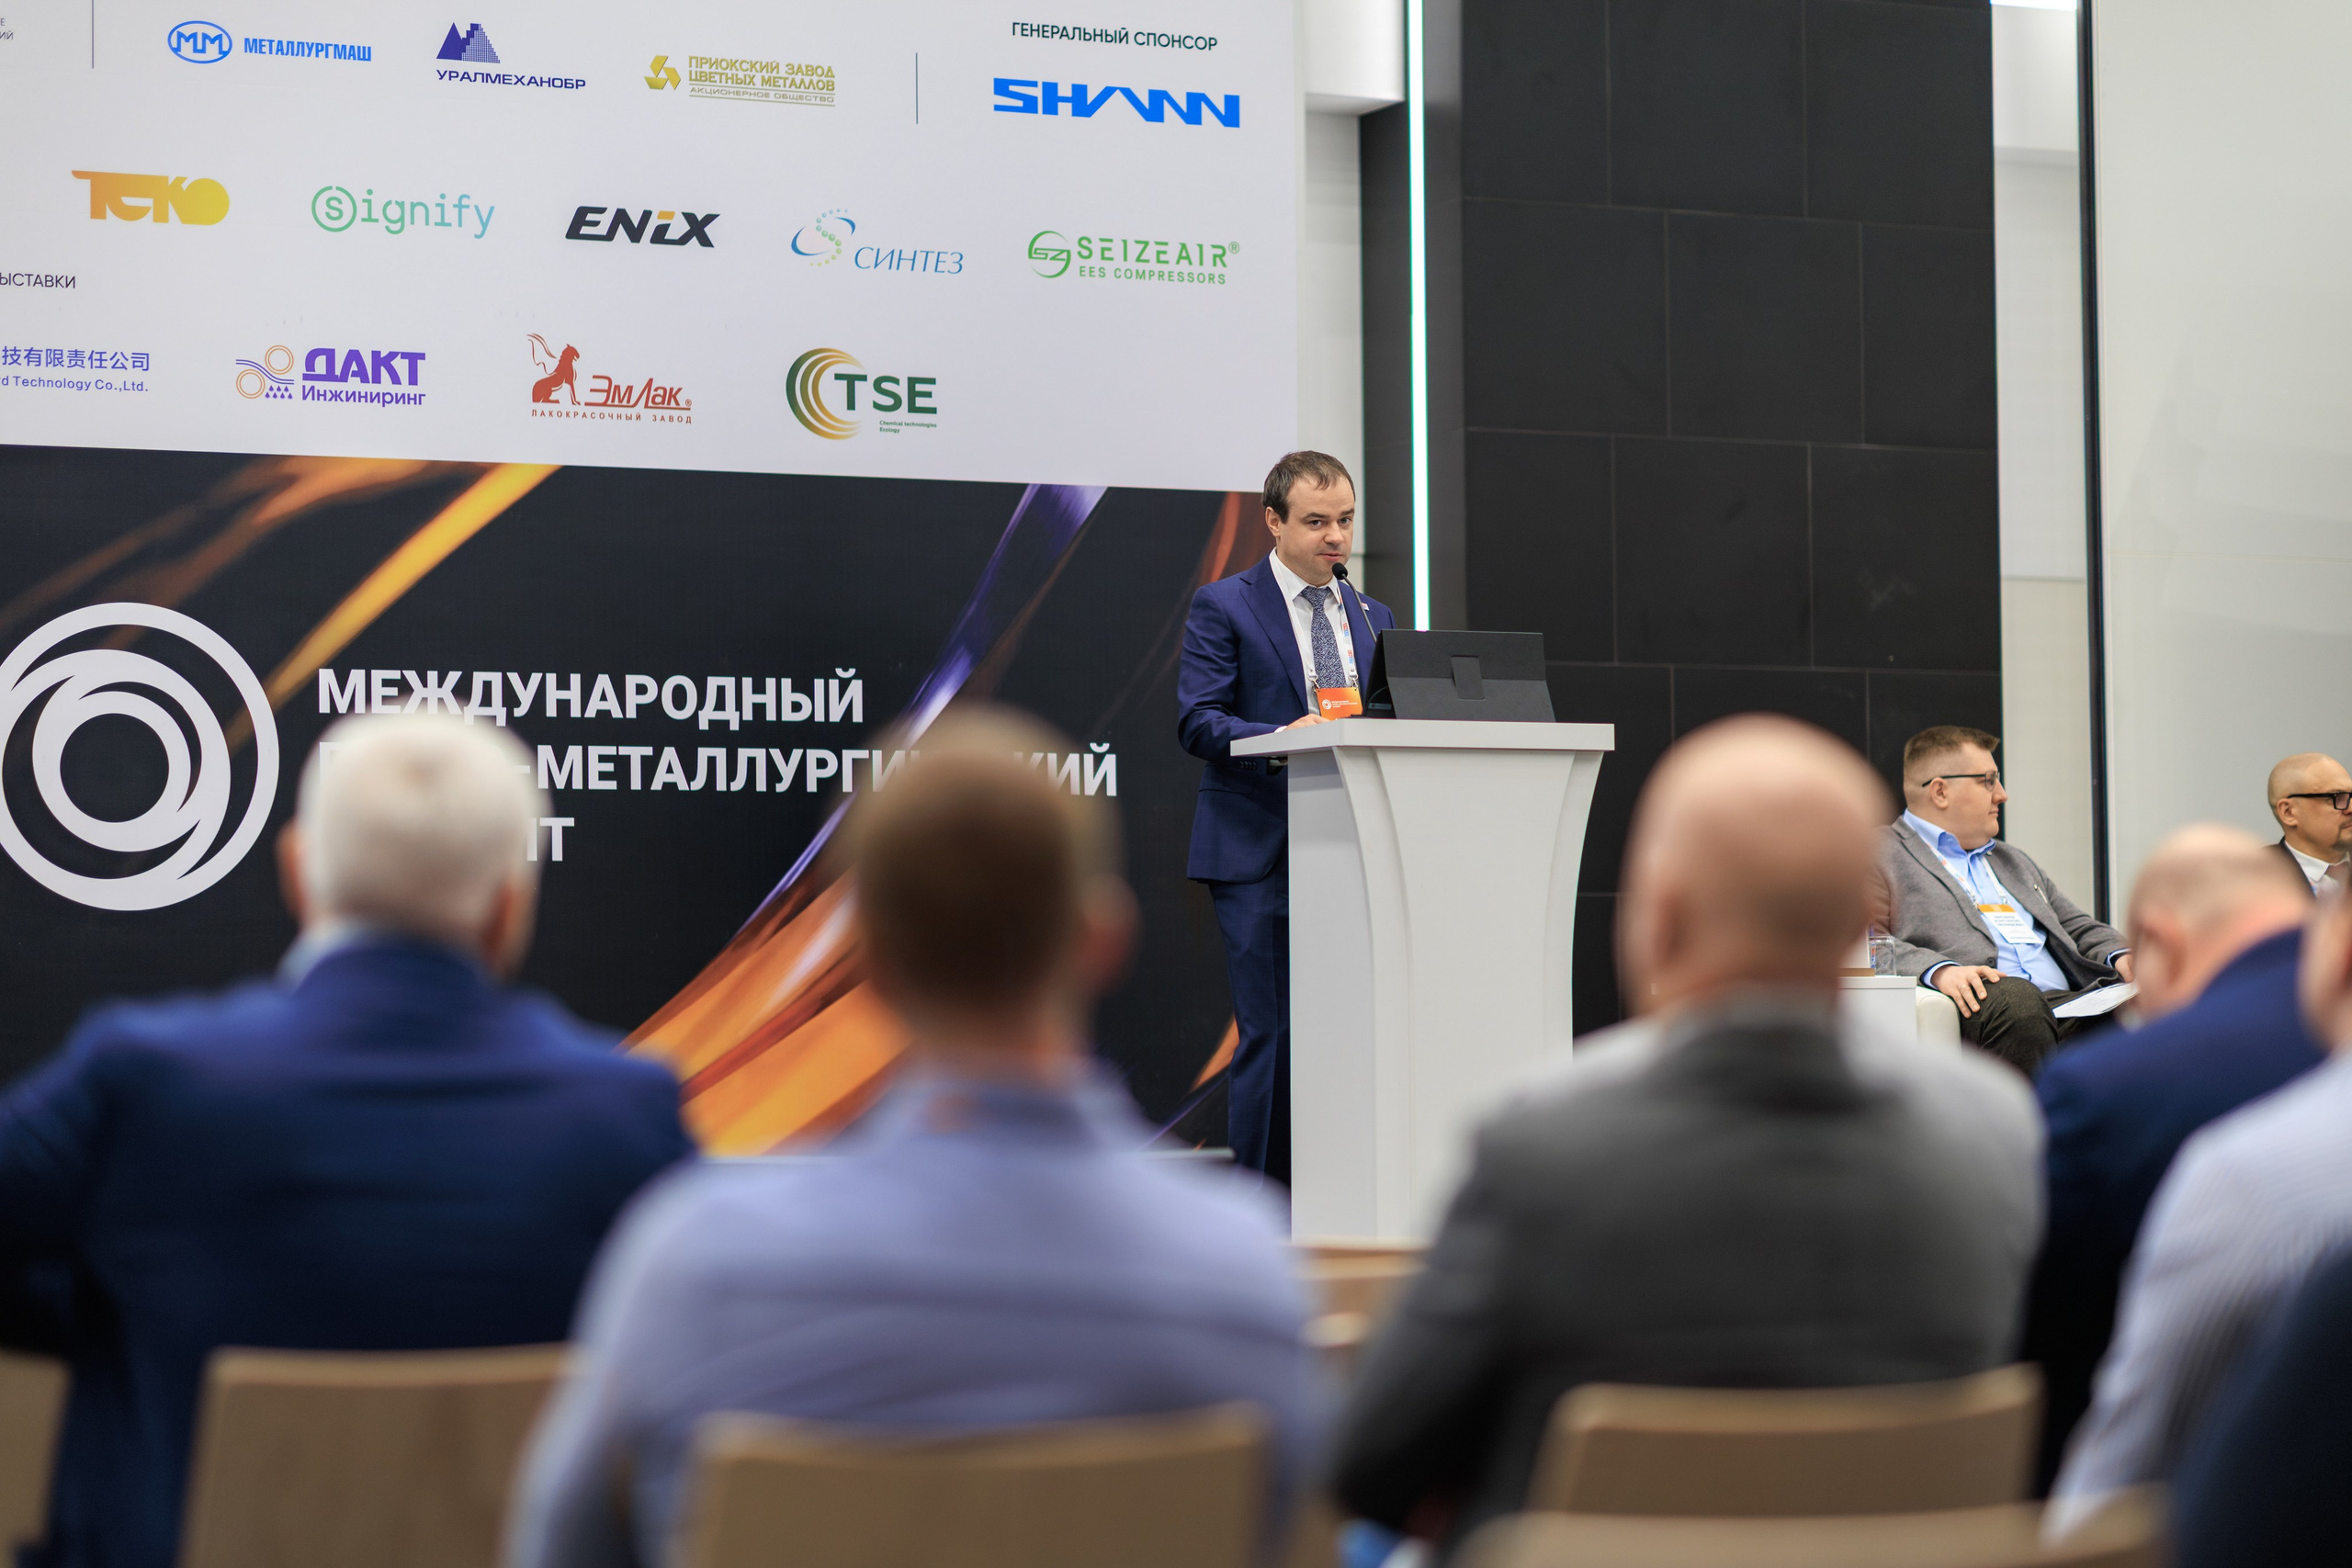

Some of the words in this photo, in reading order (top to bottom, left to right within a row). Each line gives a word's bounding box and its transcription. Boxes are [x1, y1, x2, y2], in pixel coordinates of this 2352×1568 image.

[1012, 22, 1129, 45] ГЕНЕРАЛЬНЫЙ
[1134, 31, 1218, 51] СПОНСОР
[243, 37, 372, 62] МЕТАЛЛУРГМАШ
[688, 56, 779, 73] ПРИОКСКИЙ
[785, 63, 835, 78] ЗАВОД
[435, 69, 587, 90] УРАЛМЕХАНОБР
[688, 71, 755, 85] ЦВЕТНЫХ
[761, 75, 836, 91] МЕТАЛЛОВ
[691, 87, 770, 98] АКЦИОНЕРНОЕ
[774, 95, 834, 104] ОБЩЕСТВО
[993, 77, 1240, 129] SHANN
[854, 246, 965, 275] СИНТЕЗ
[1079, 265, 1107, 278] EES
[1114, 267, 1227, 285] COMPRESSORS
[2, 345, 150, 372] 技有限责任公司
[302, 347, 426, 386] ДАКТ
[12, 376, 92, 391] Technology
[95, 378, 149, 392] Co.,Ltd.
[301, 384, 426, 408] Инжиниринг
[834, 373, 937, 414] TSE
[531, 409, 641, 422] ЛАКОКРАСОЧНЫЙ
[651, 413, 692, 424] ЗАВОД
[318, 667, 865, 731] МЕЖДУНАРОДНЫЙ
